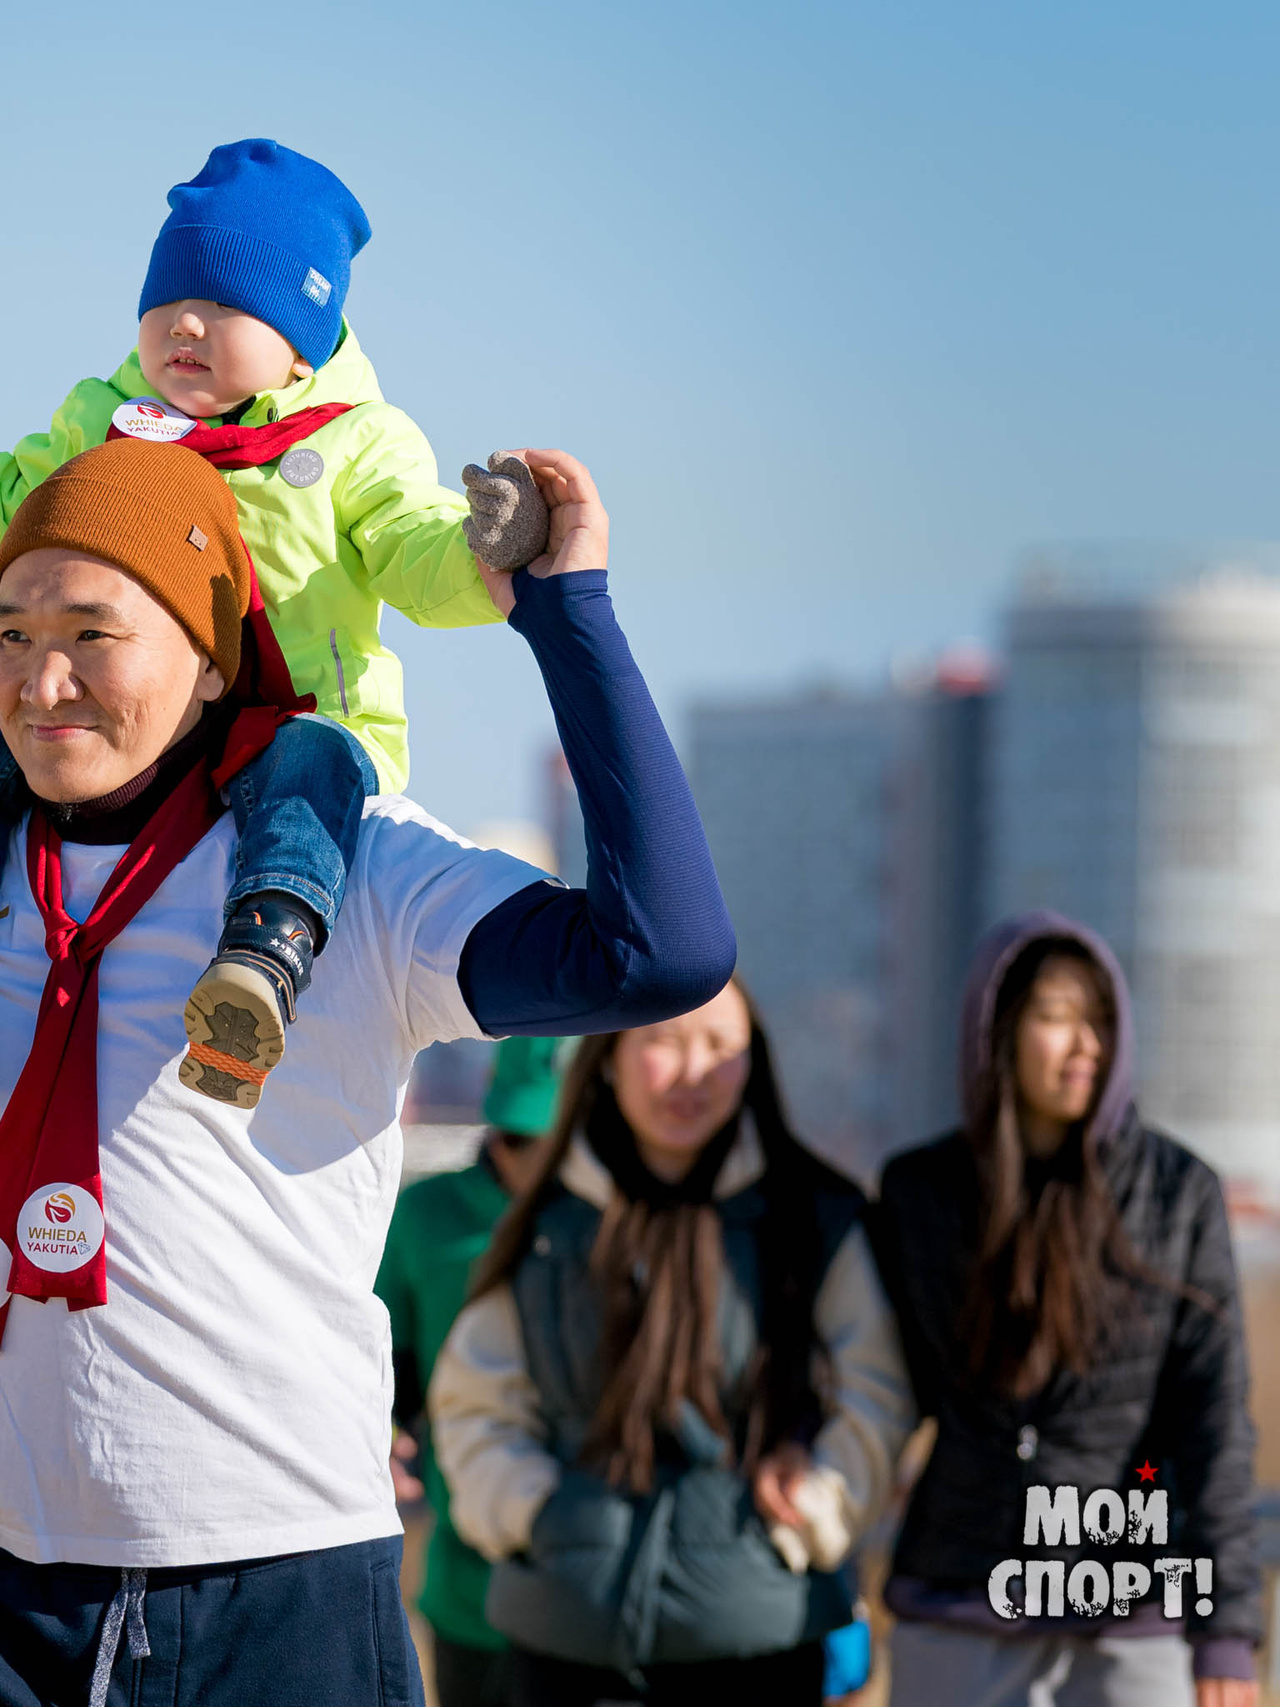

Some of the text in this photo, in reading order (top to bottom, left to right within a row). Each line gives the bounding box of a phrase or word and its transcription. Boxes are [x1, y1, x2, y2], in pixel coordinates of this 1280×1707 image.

[125, 419, 183, 431] WHIEDA
[127, 427, 180, 436] YAKUTIA
[28, 1226, 87, 1243] WHIEDA
[27, 1242, 78, 1255] YAKUTIA
